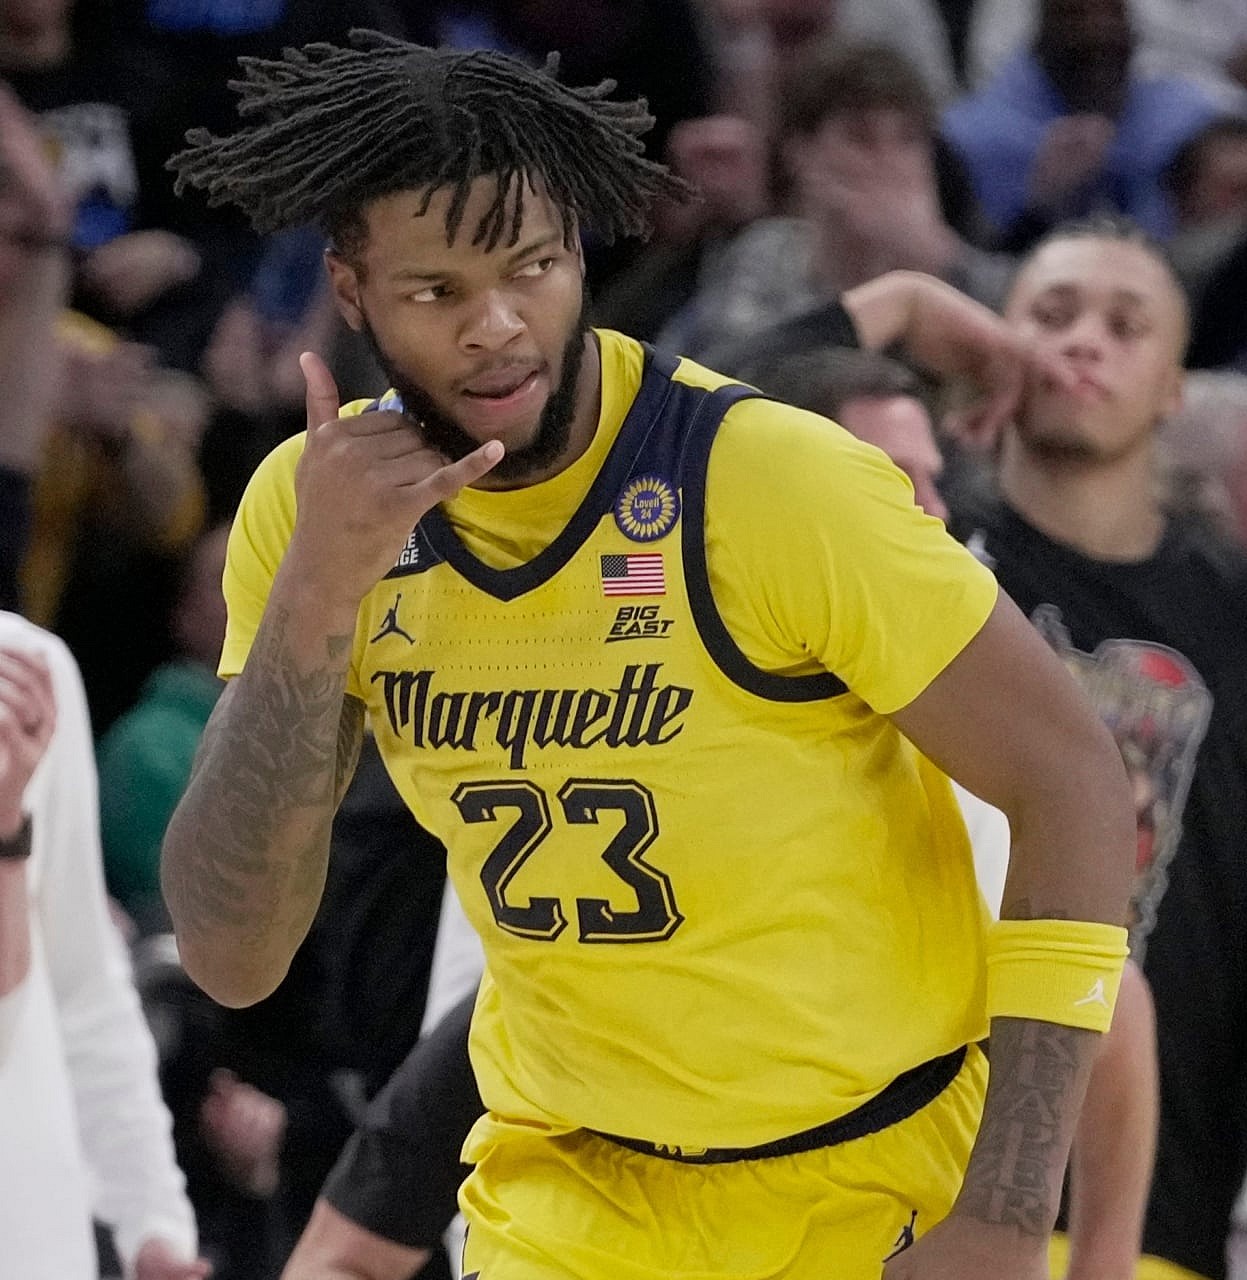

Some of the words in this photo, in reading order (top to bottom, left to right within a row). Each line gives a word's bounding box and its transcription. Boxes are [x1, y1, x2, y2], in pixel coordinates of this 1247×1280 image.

[394, 548, 420, 567] GE
[616, 606, 661, 620] BIG
[609, 619, 676, 635] EAST
[371, 663, 694, 770] Marquette
[450, 777, 686, 944] 23
